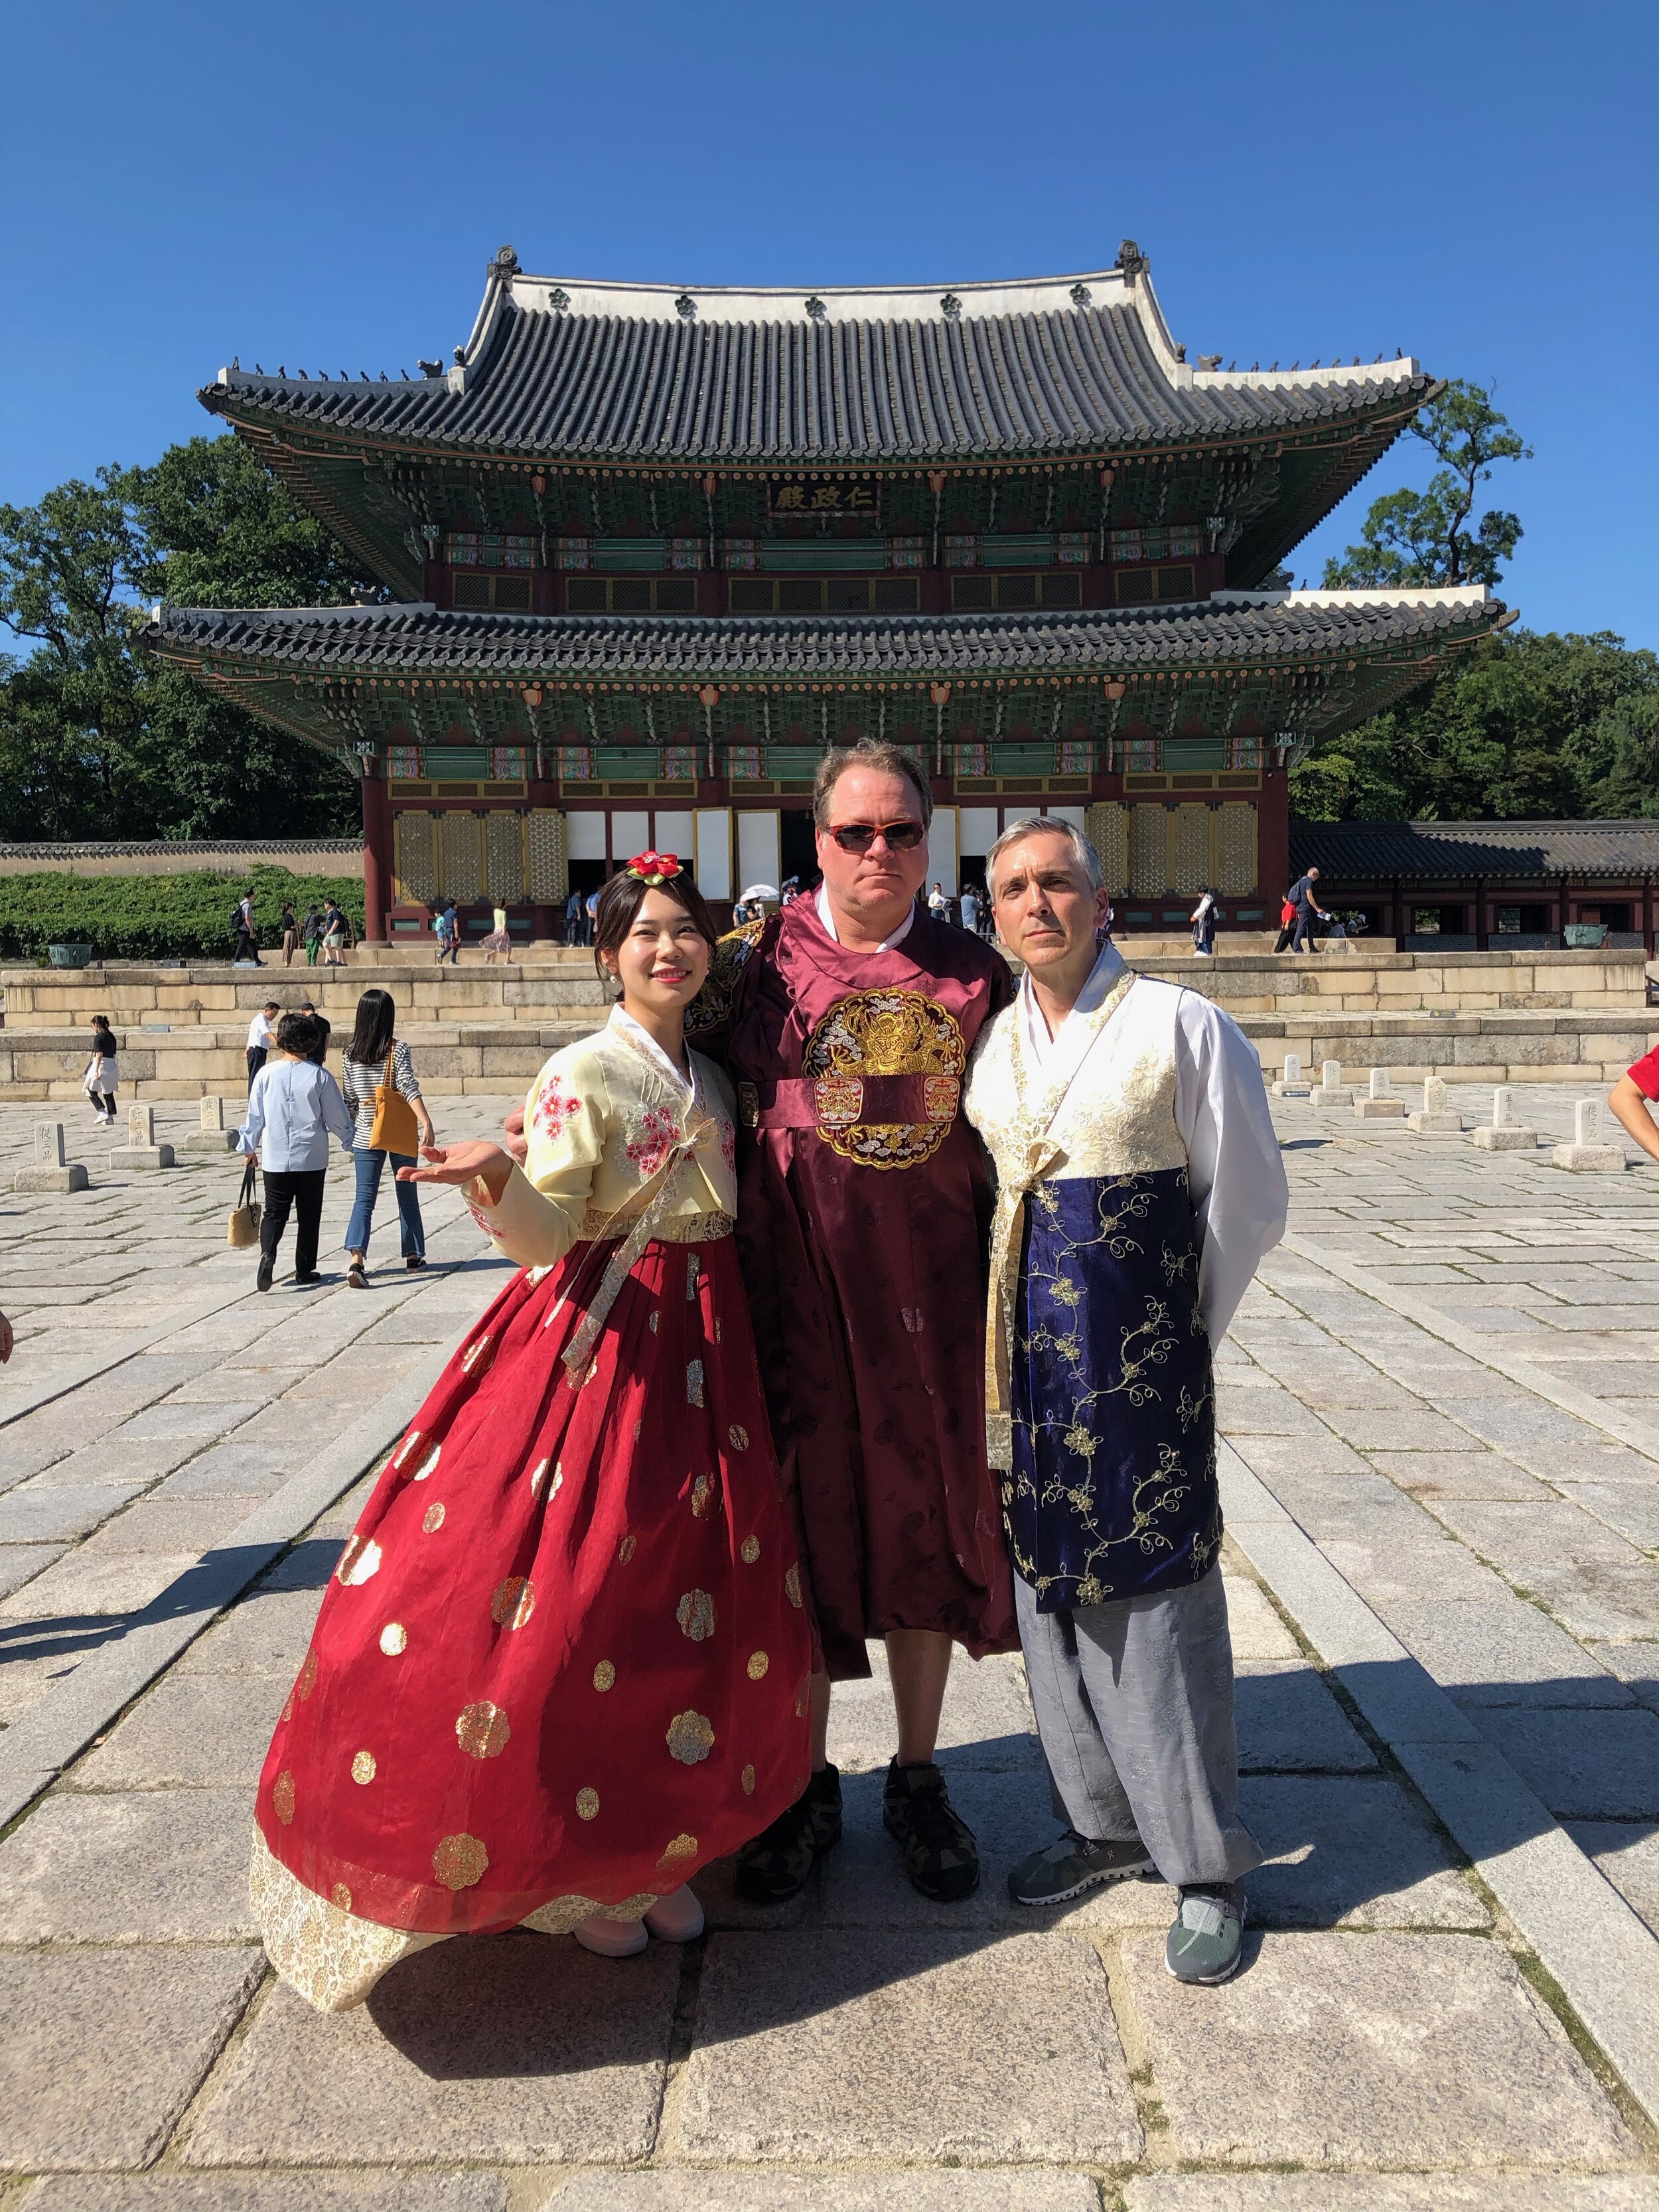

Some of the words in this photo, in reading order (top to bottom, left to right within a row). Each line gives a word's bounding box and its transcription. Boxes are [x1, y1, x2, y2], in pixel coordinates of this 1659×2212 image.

[1376, 1072, 1386, 1097] 正二品
[1503, 1093, 1514, 1123] 正三品
[1587, 1105, 1598, 1139] 從三品
[133, 1110, 144, 1141] 正三品
[40, 1127, 52, 1161] 從三品
